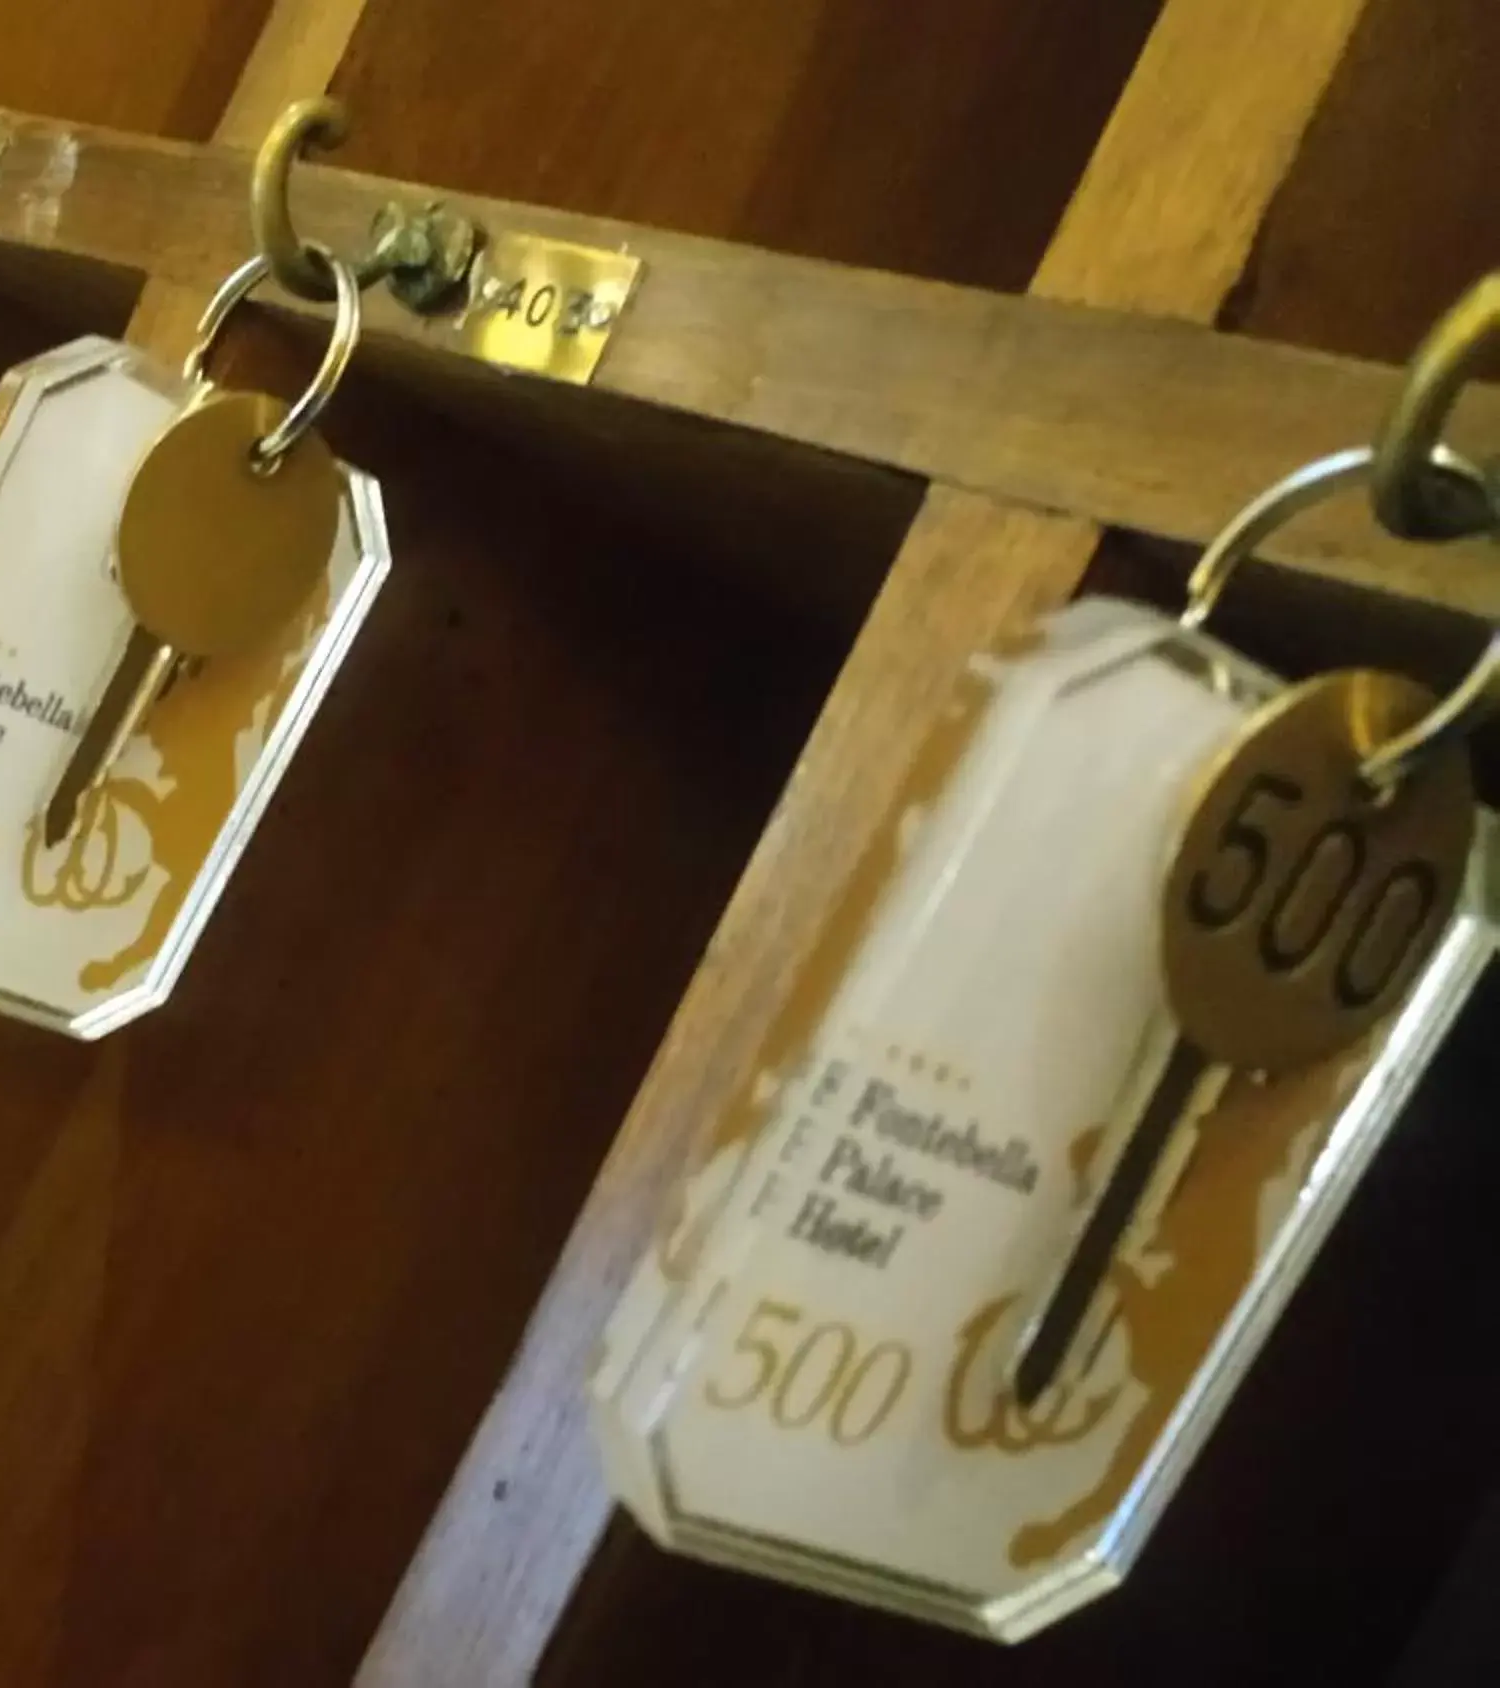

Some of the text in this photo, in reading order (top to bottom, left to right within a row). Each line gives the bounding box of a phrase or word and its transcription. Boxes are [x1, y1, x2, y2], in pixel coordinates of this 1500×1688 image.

[1187, 772, 1437, 1010] 500
[819, 1134, 945, 1222] Palace
[850, 1076, 1040, 1196] Fontebella
[787, 1188, 905, 1270] Hotel
[704, 1297, 912, 1447] 500
